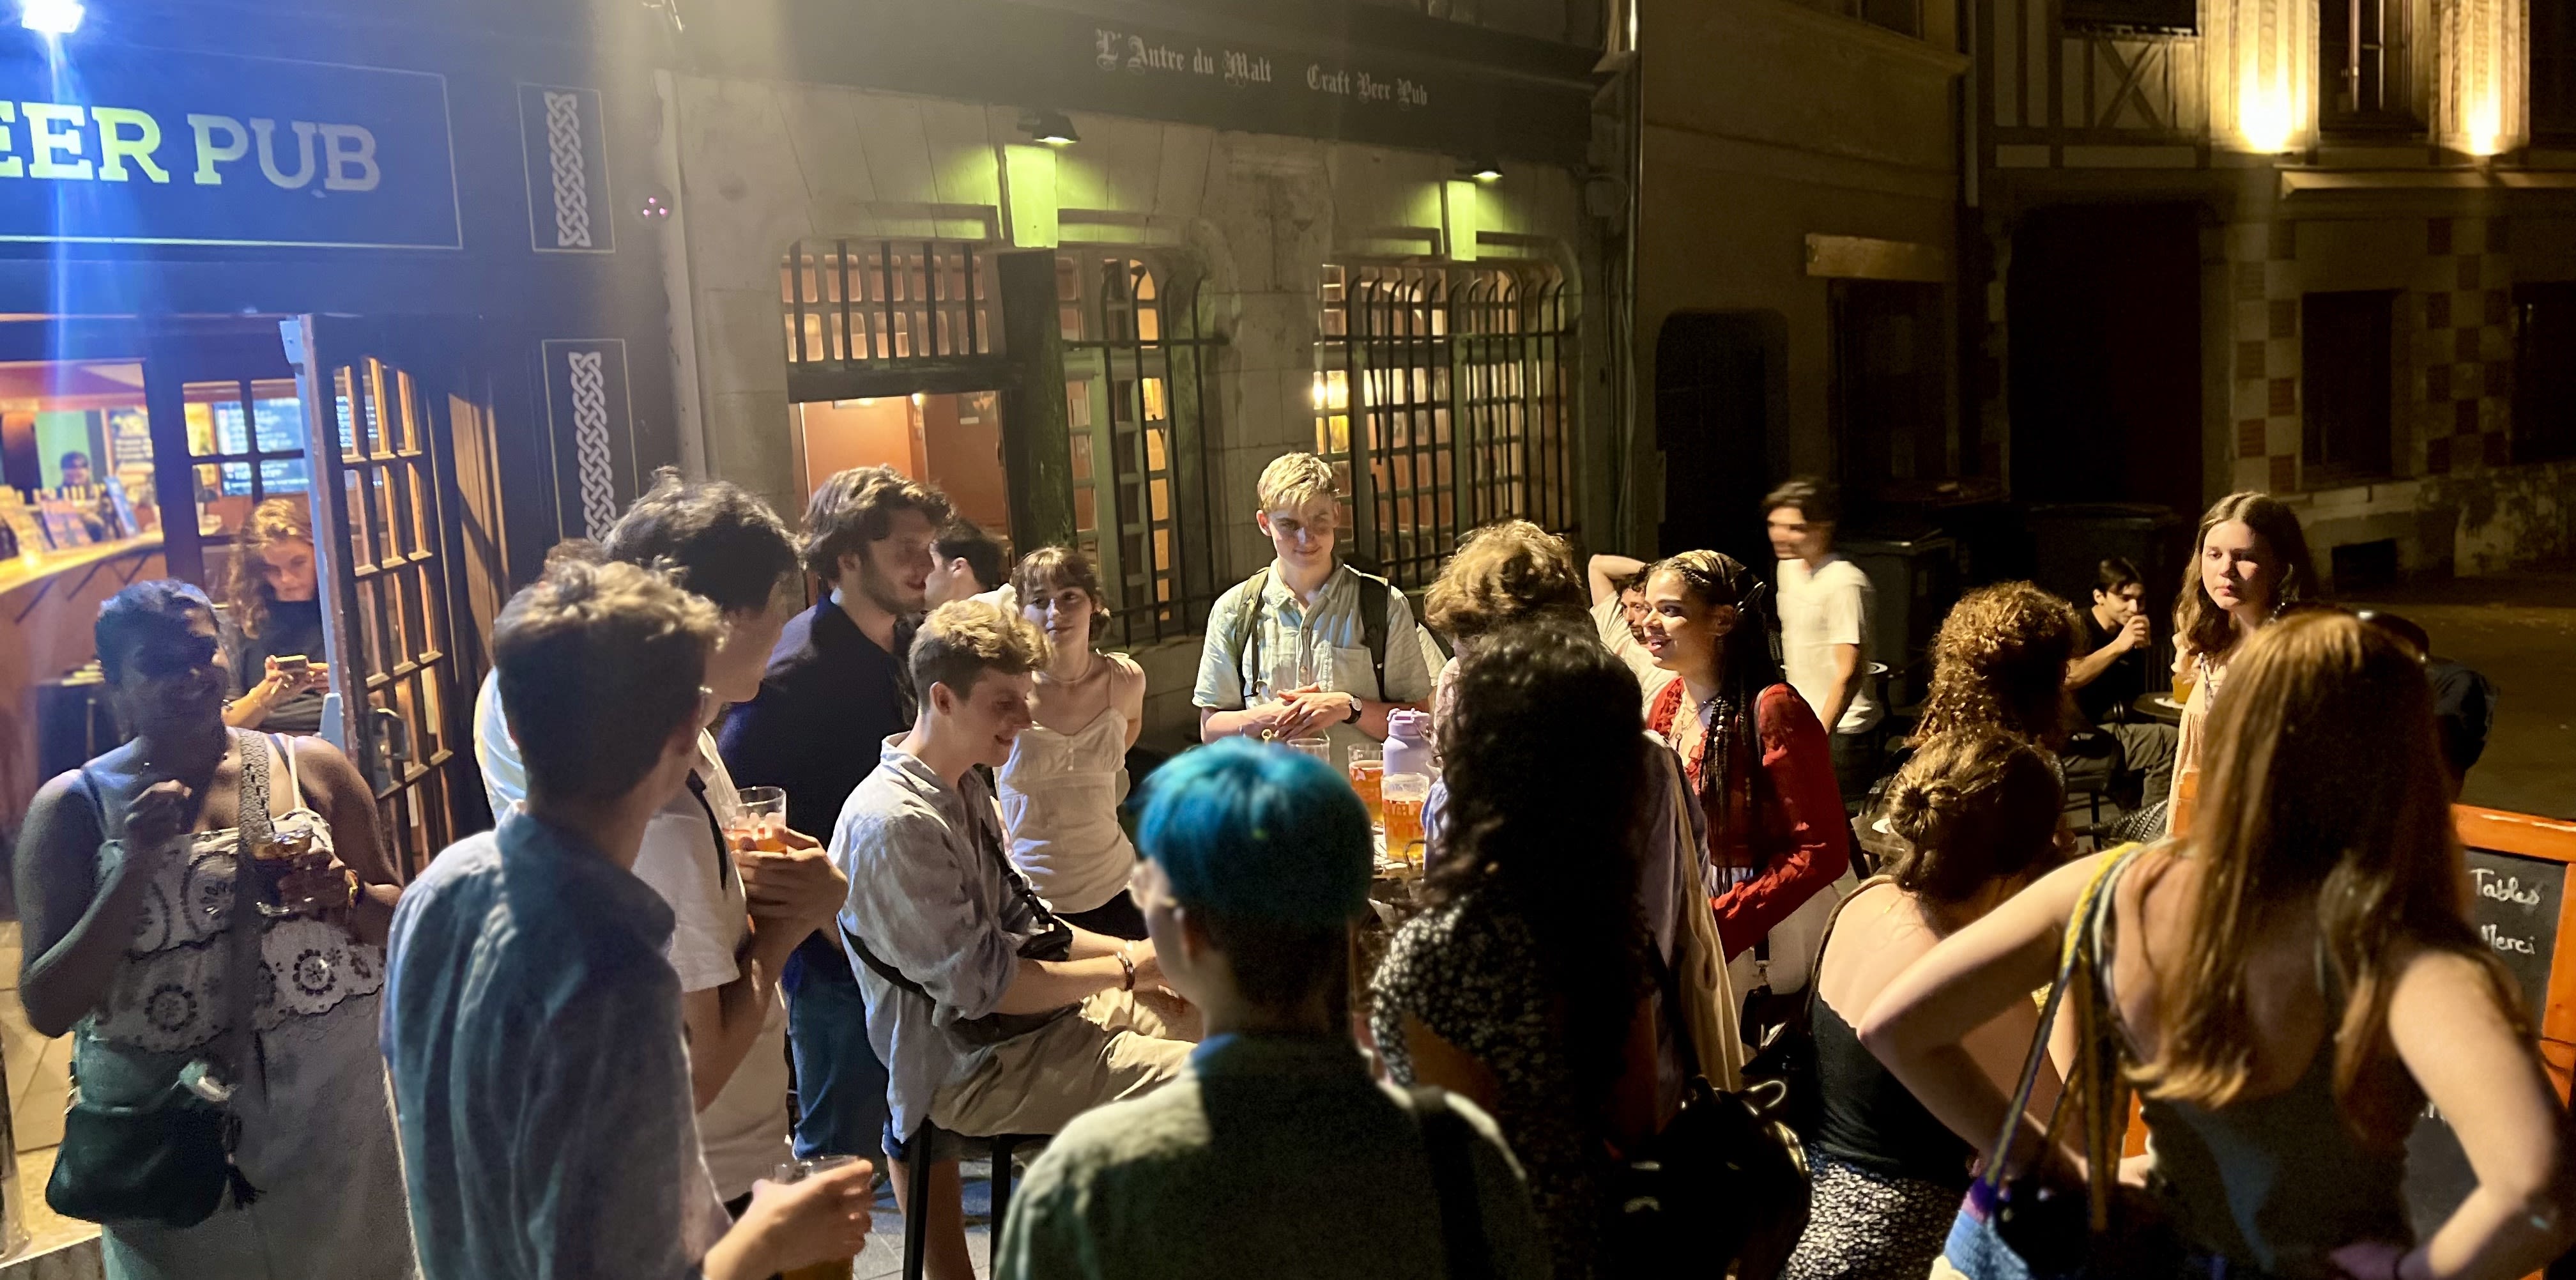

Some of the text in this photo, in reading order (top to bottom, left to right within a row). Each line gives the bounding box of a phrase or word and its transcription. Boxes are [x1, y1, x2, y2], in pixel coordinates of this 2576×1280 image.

[1193, 47, 1214, 74] du
[1223, 50, 1271, 87] Malt
[1307, 64, 1427, 111] Craft Beer Pub
[187, 114, 380, 191] PUB
[2469, 868, 2540, 906] Tables
[2481, 924, 2535, 955] Merci
